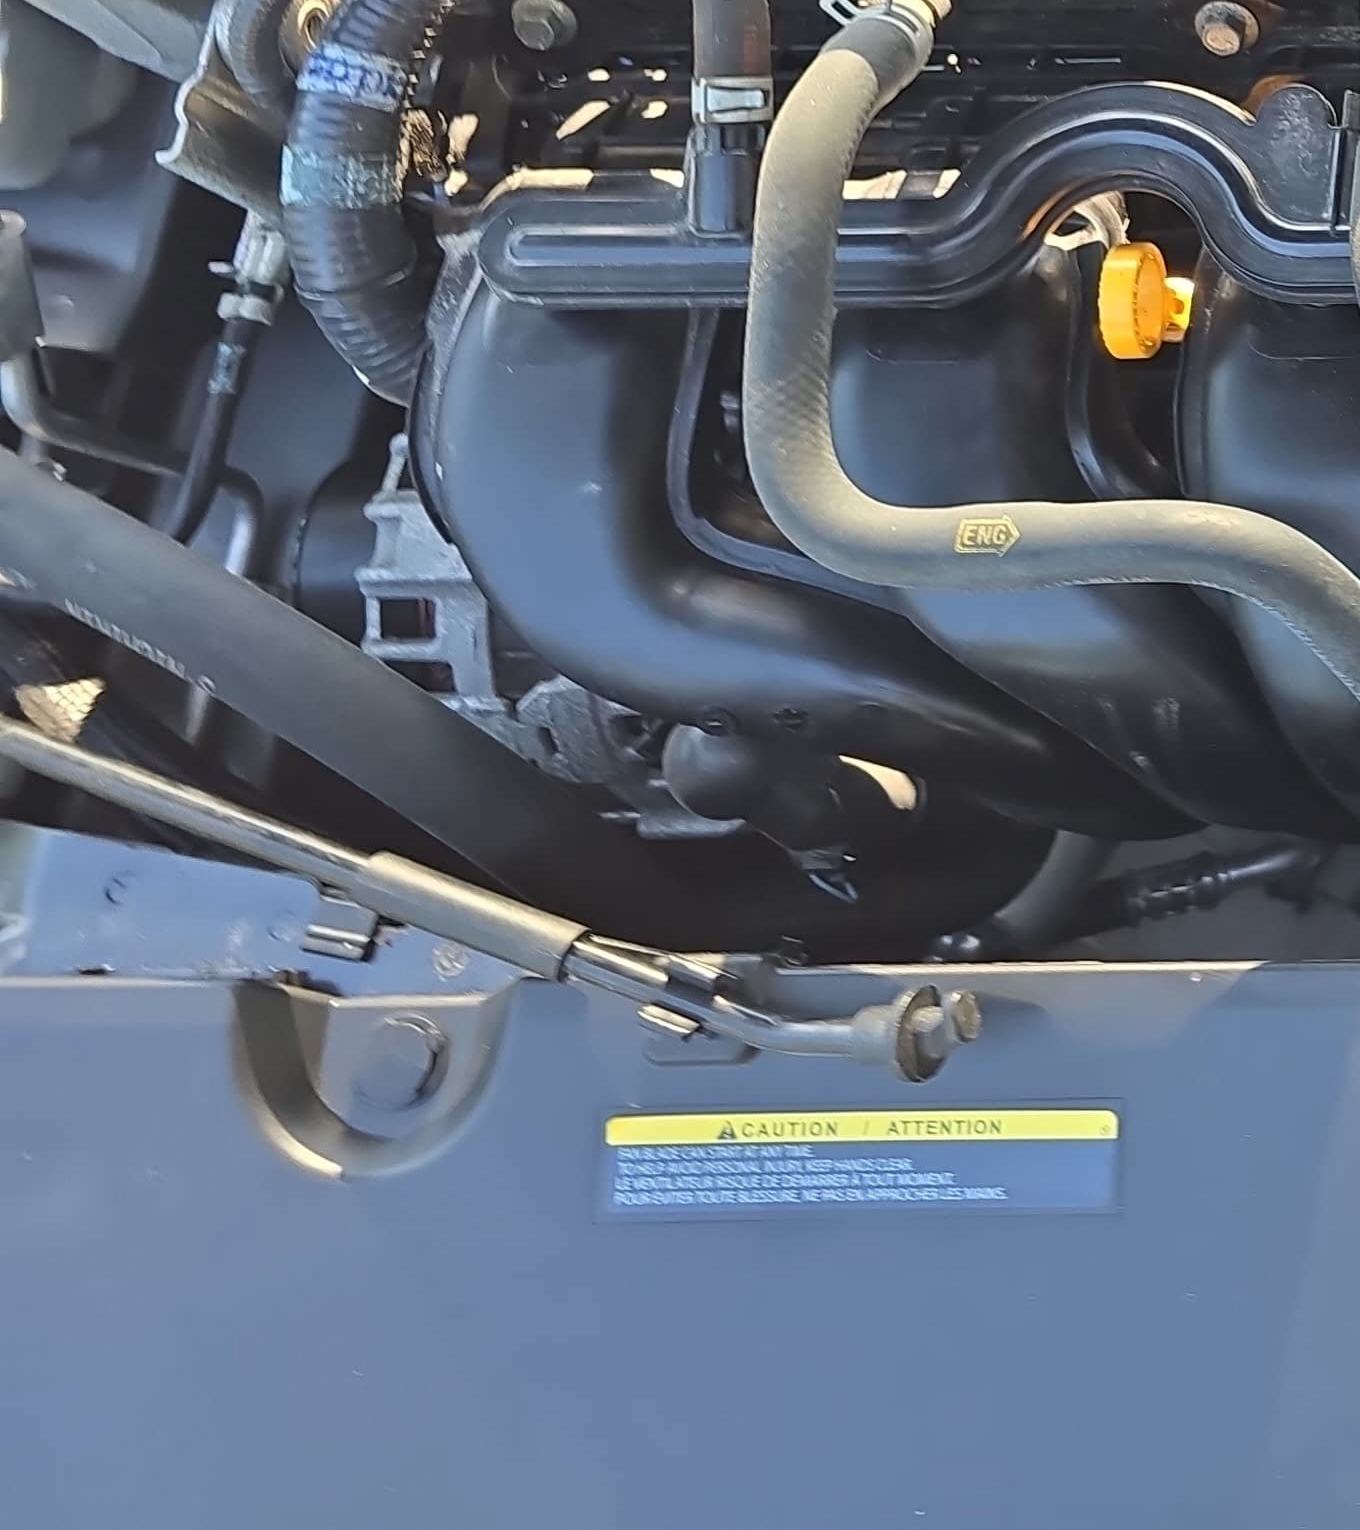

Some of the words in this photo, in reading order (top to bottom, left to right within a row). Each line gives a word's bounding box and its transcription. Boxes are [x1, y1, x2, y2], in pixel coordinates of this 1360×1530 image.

[962, 524, 1007, 547] ENG
[741, 1120, 838, 1139] CAUTION
[886, 1119, 1002, 1136] ATTENTION
